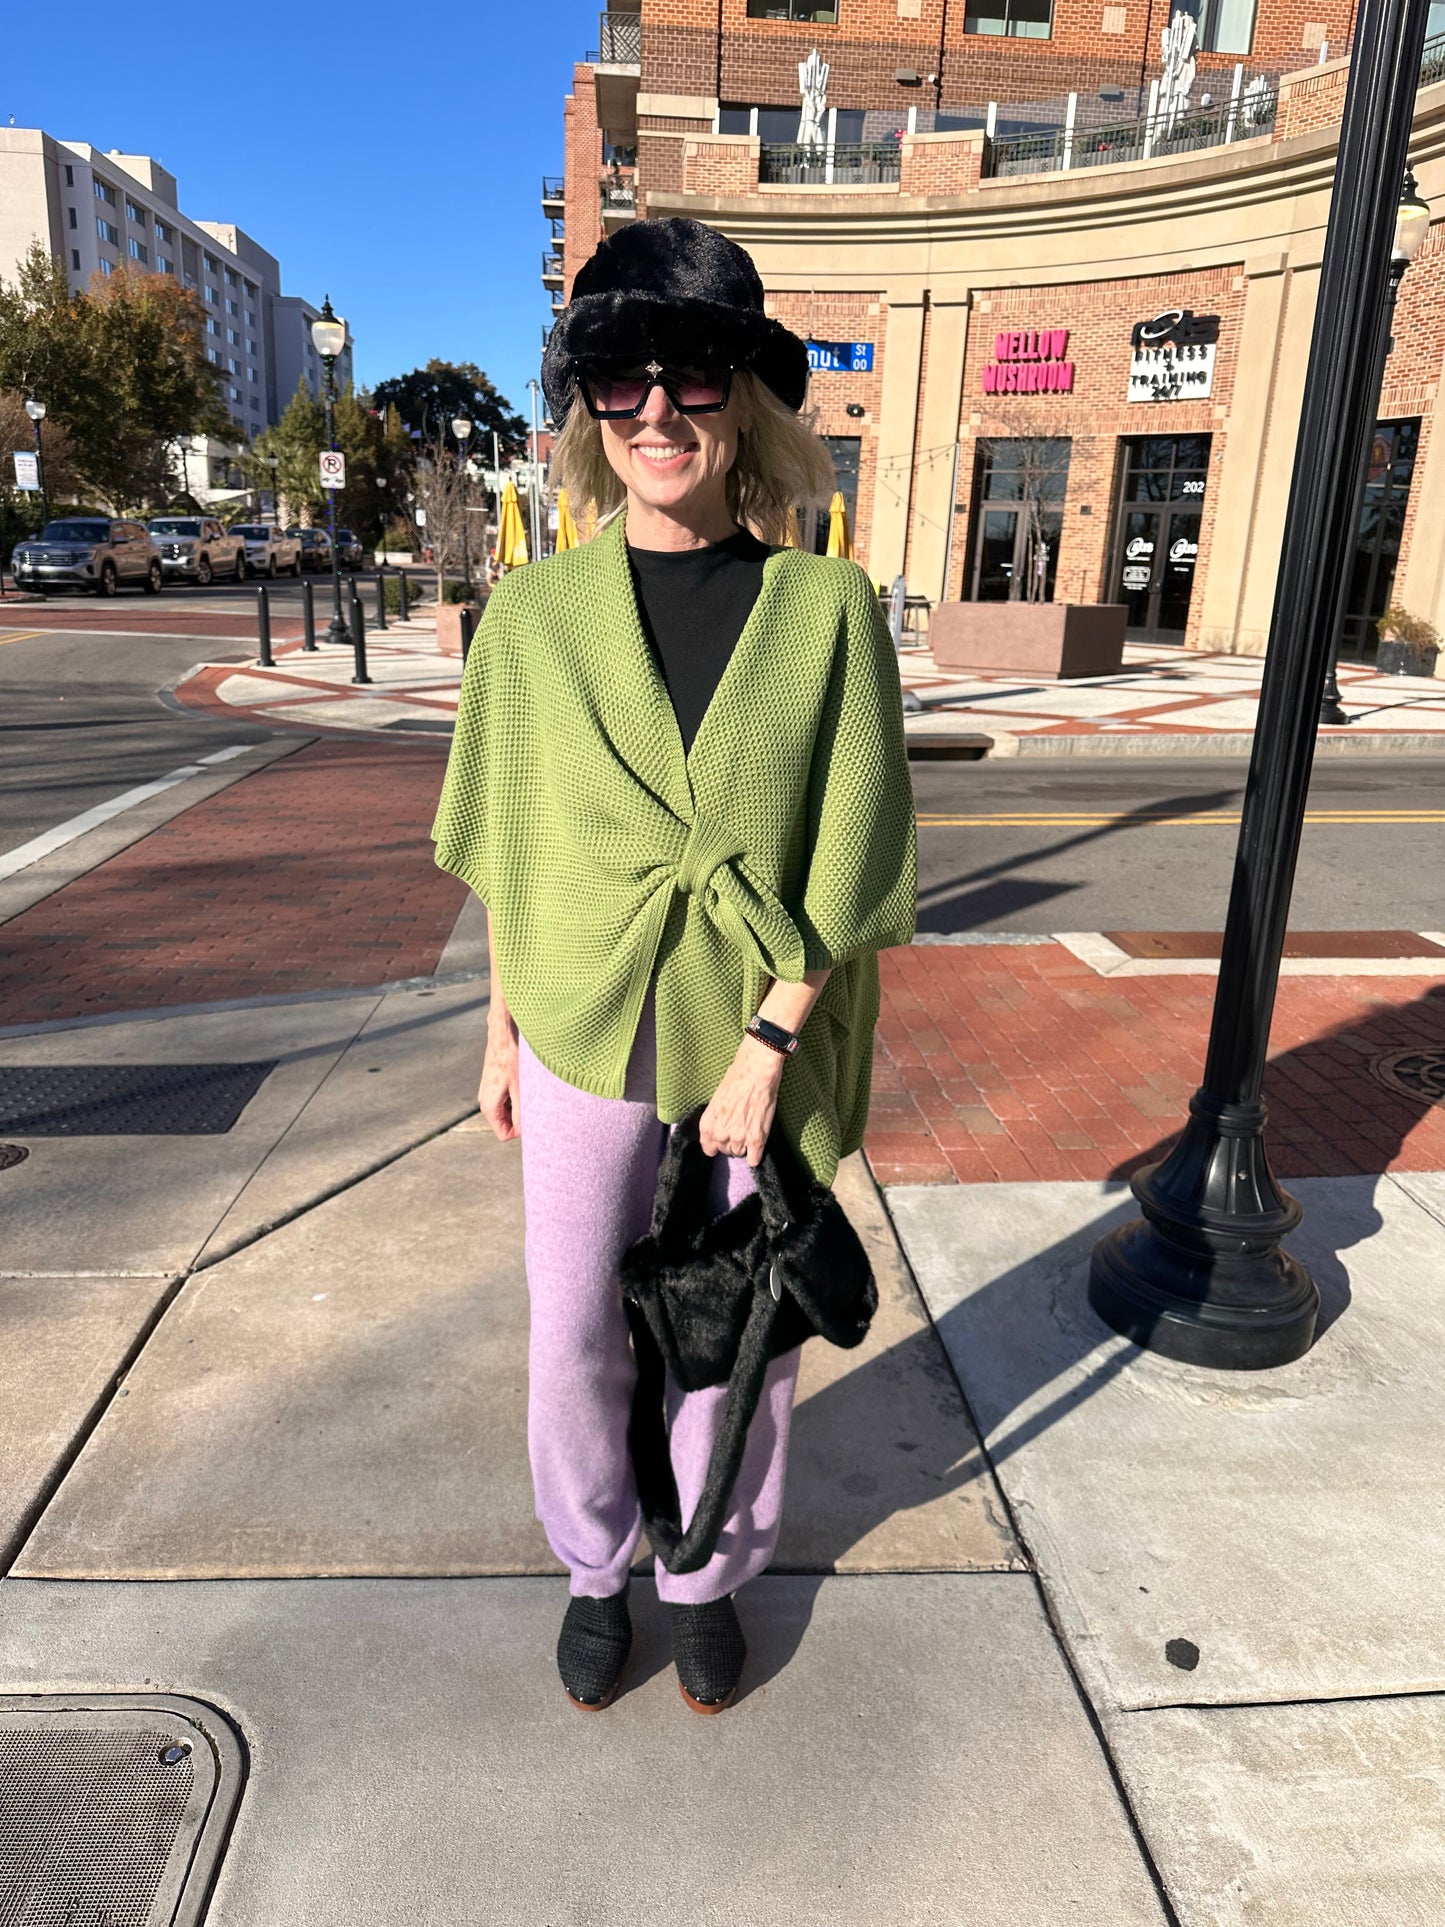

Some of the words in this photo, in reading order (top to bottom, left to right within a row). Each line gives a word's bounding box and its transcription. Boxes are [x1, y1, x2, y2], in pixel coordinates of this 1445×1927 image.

[995, 329, 1068, 361] MELLOW
[1134, 344, 1208, 362] FITNESS
[807, 346, 840, 368] nut
[855, 344, 867, 356] St
[852, 358, 868, 371] 00
[983, 361, 1073, 393] MUSHROOM
[1130, 370, 1208, 387] TRAINING
[1182, 481, 1205, 494] 202
